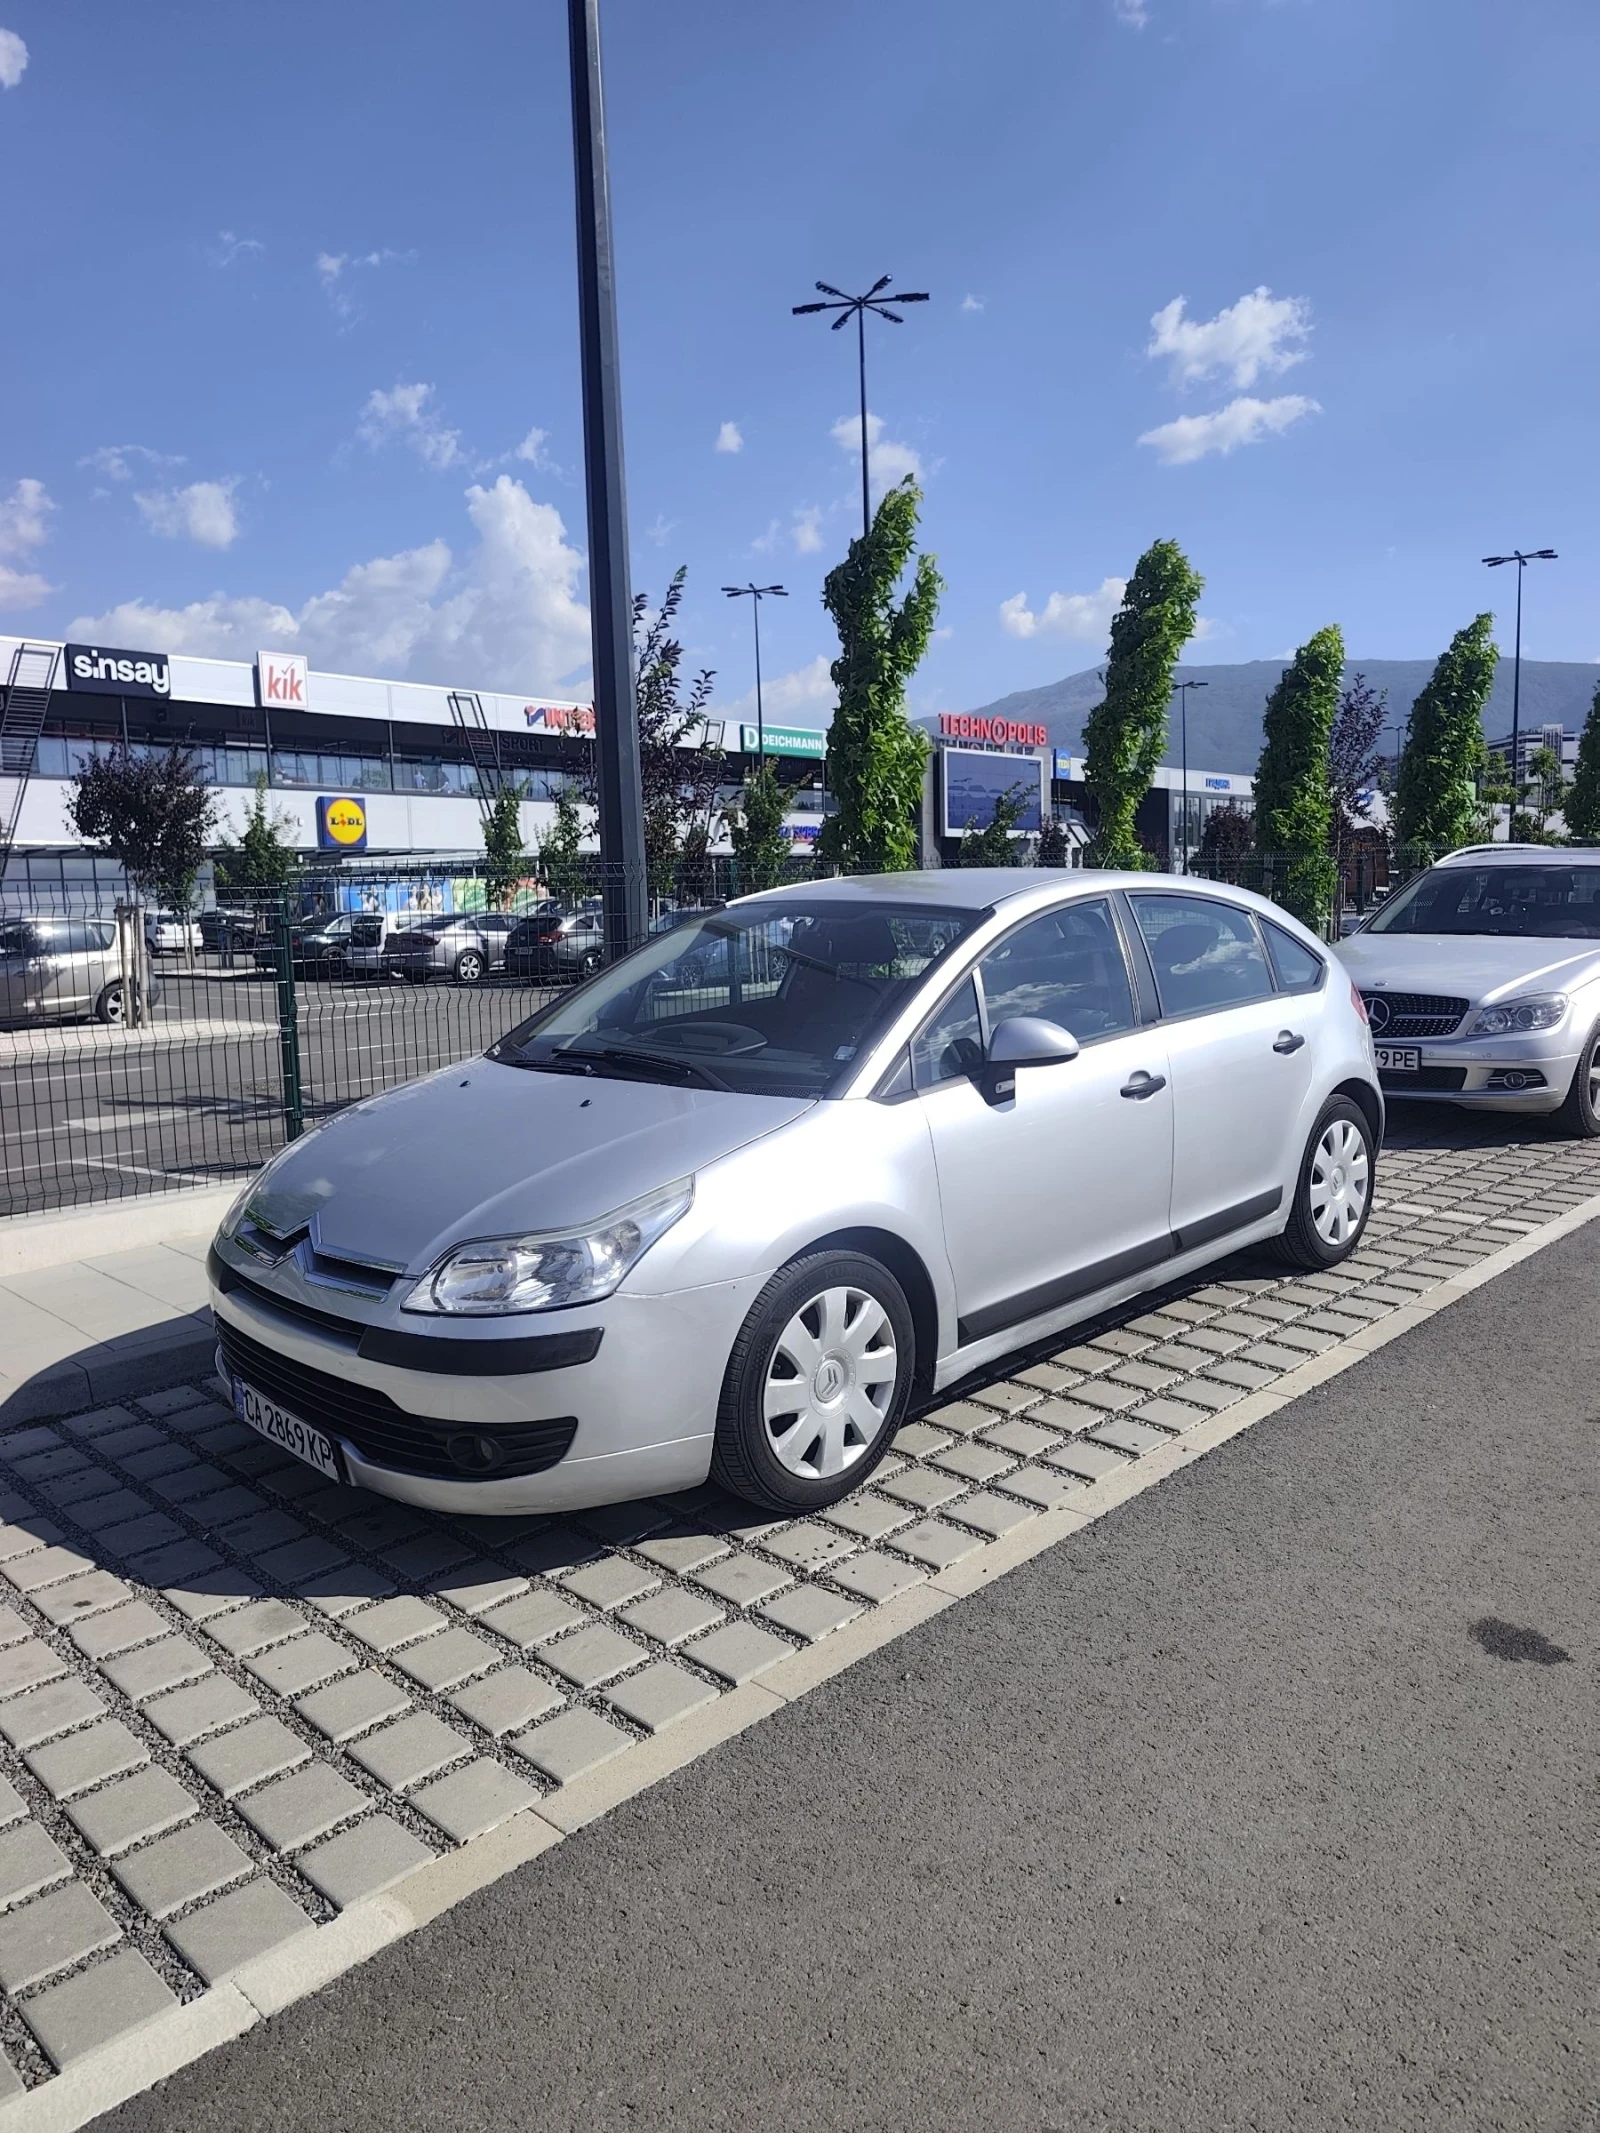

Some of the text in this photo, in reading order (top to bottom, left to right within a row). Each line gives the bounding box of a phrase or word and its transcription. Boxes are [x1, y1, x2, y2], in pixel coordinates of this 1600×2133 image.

[73, 650, 170, 694] sinsay
[267, 663, 303, 702] kik
[762, 733, 822, 751] DEICHMANN
[939, 713, 1047, 746] TECHNOPOLIS
[330, 813, 363, 828] LIDL
[1393, 1051, 1415, 1068] PE
[244, 1389, 331, 1469] CA 2869 KP
